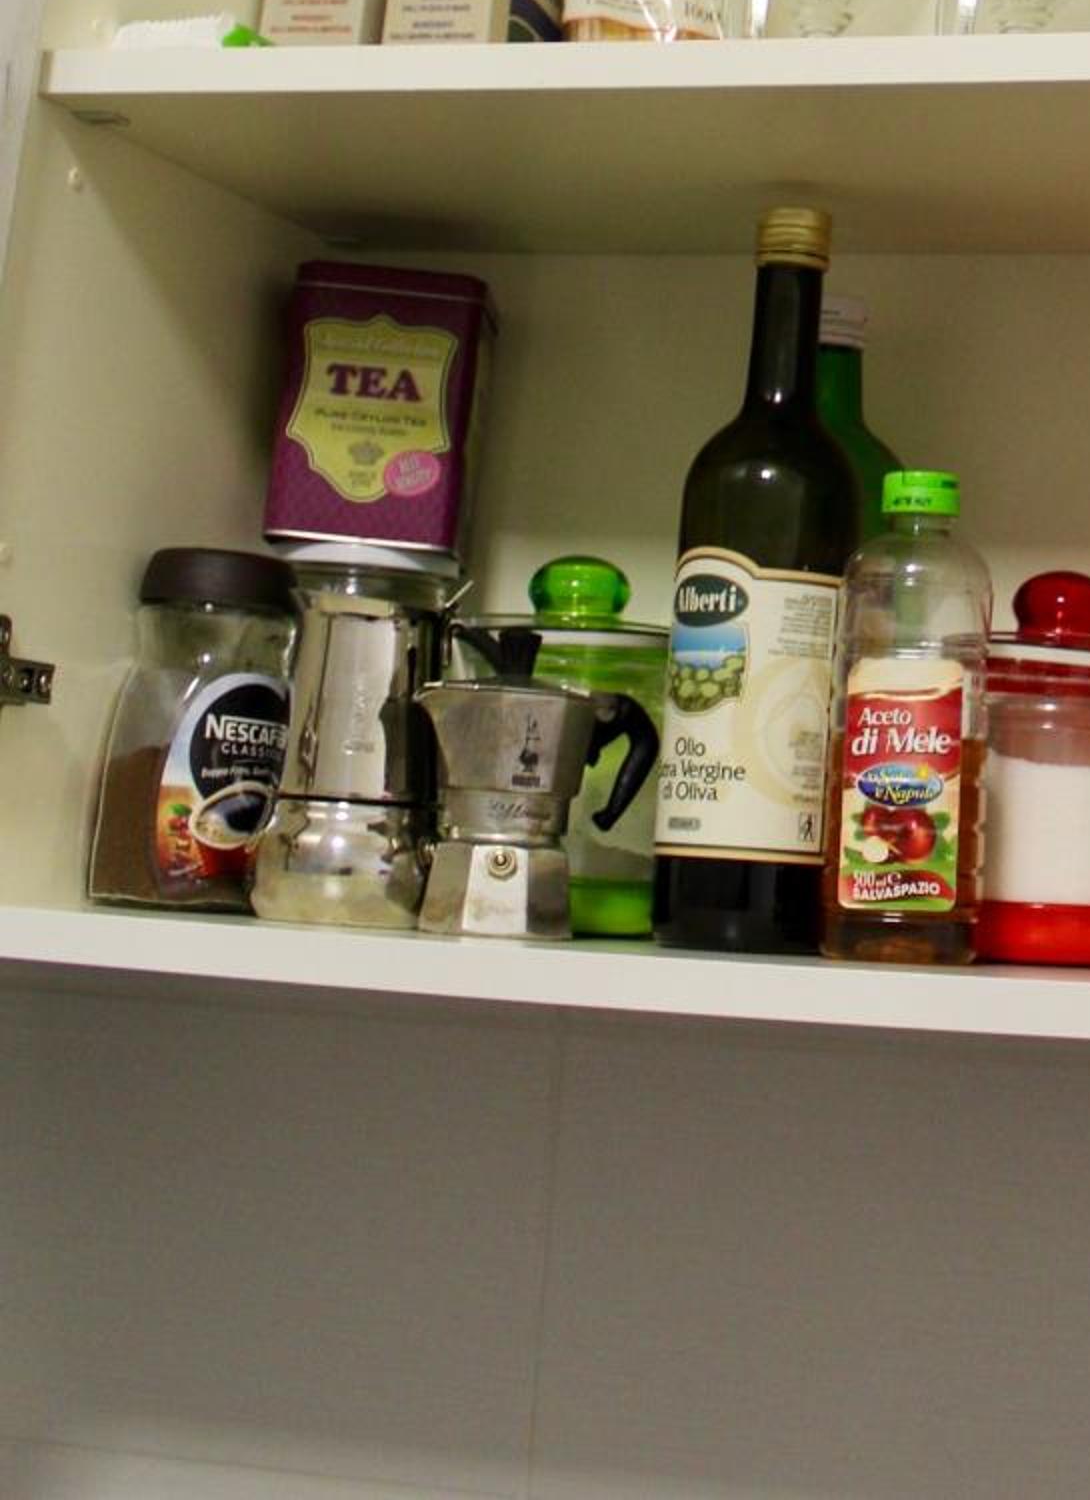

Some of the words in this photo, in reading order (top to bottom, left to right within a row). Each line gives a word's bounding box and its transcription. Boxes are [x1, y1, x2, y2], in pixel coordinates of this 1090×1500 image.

[326, 363, 424, 404] TEA
[676, 584, 738, 613] Alberti
[856, 707, 913, 728] Aceto
[220, 741, 284, 761] CLASS
[674, 735, 707, 757] Olio
[851, 726, 880, 757] di
[884, 725, 952, 755] Mele
[680, 759, 747, 785] Vergine
[674, 780, 719, 802] Oliva
[852, 880, 942, 902] SALVASPAZIO
